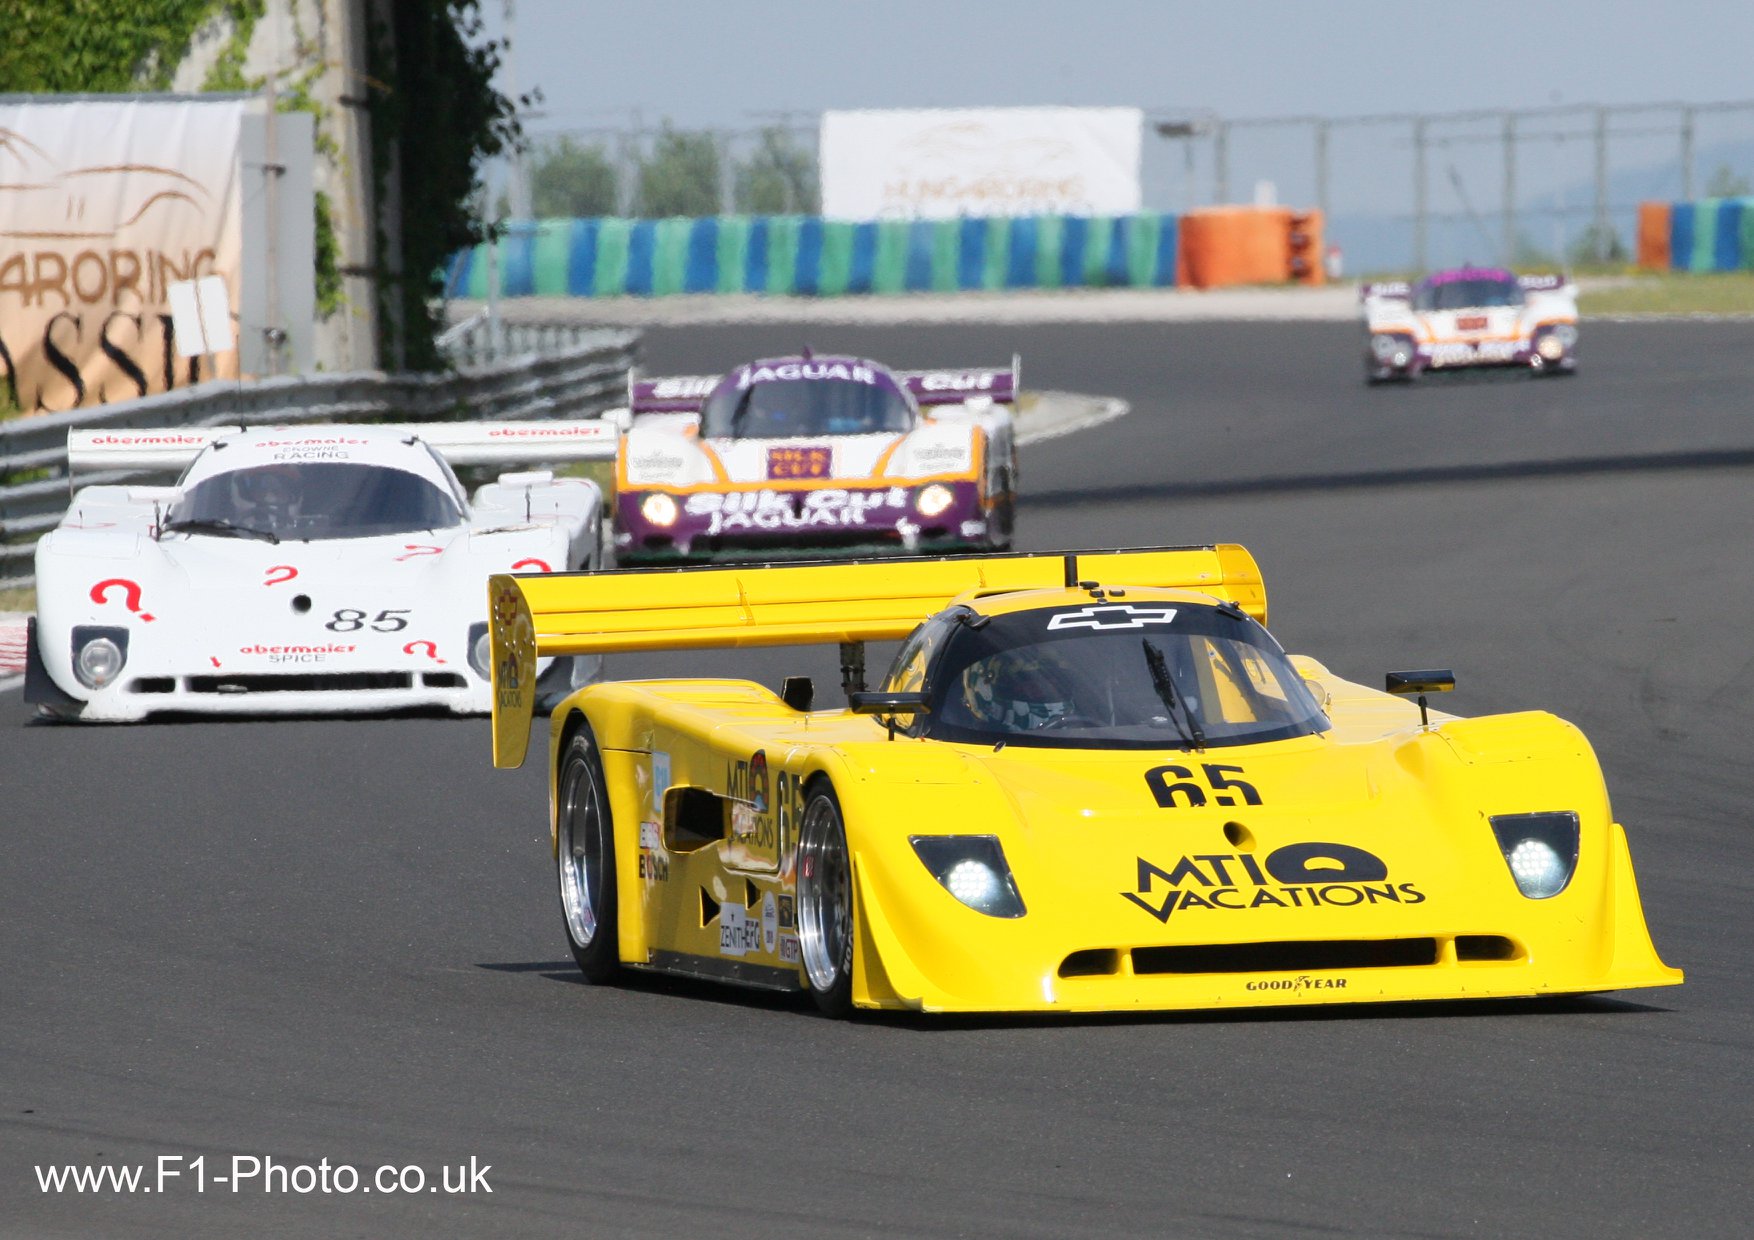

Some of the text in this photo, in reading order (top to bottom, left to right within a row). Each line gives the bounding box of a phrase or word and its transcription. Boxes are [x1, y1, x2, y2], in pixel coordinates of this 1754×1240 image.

[735, 363, 876, 390] JAGUAR
[91, 434, 204, 445] obermaier
[255, 436, 369, 448] obermaier
[488, 426, 601, 437] obermaier
[273, 450, 350, 460] RACING
[684, 486, 908, 515] Silk Cut
[707, 507, 866, 536] JAGUAR
[325, 608, 412, 632] 85
[240, 643, 357, 655] obermaier
[268, 654, 327, 663] SPICE
[1144, 763, 1264, 809] 65
[639, 854, 669, 882] BOSCH
[1137, 853, 1267, 893] MTI
[1119, 882, 1427, 925] VACATIONS
